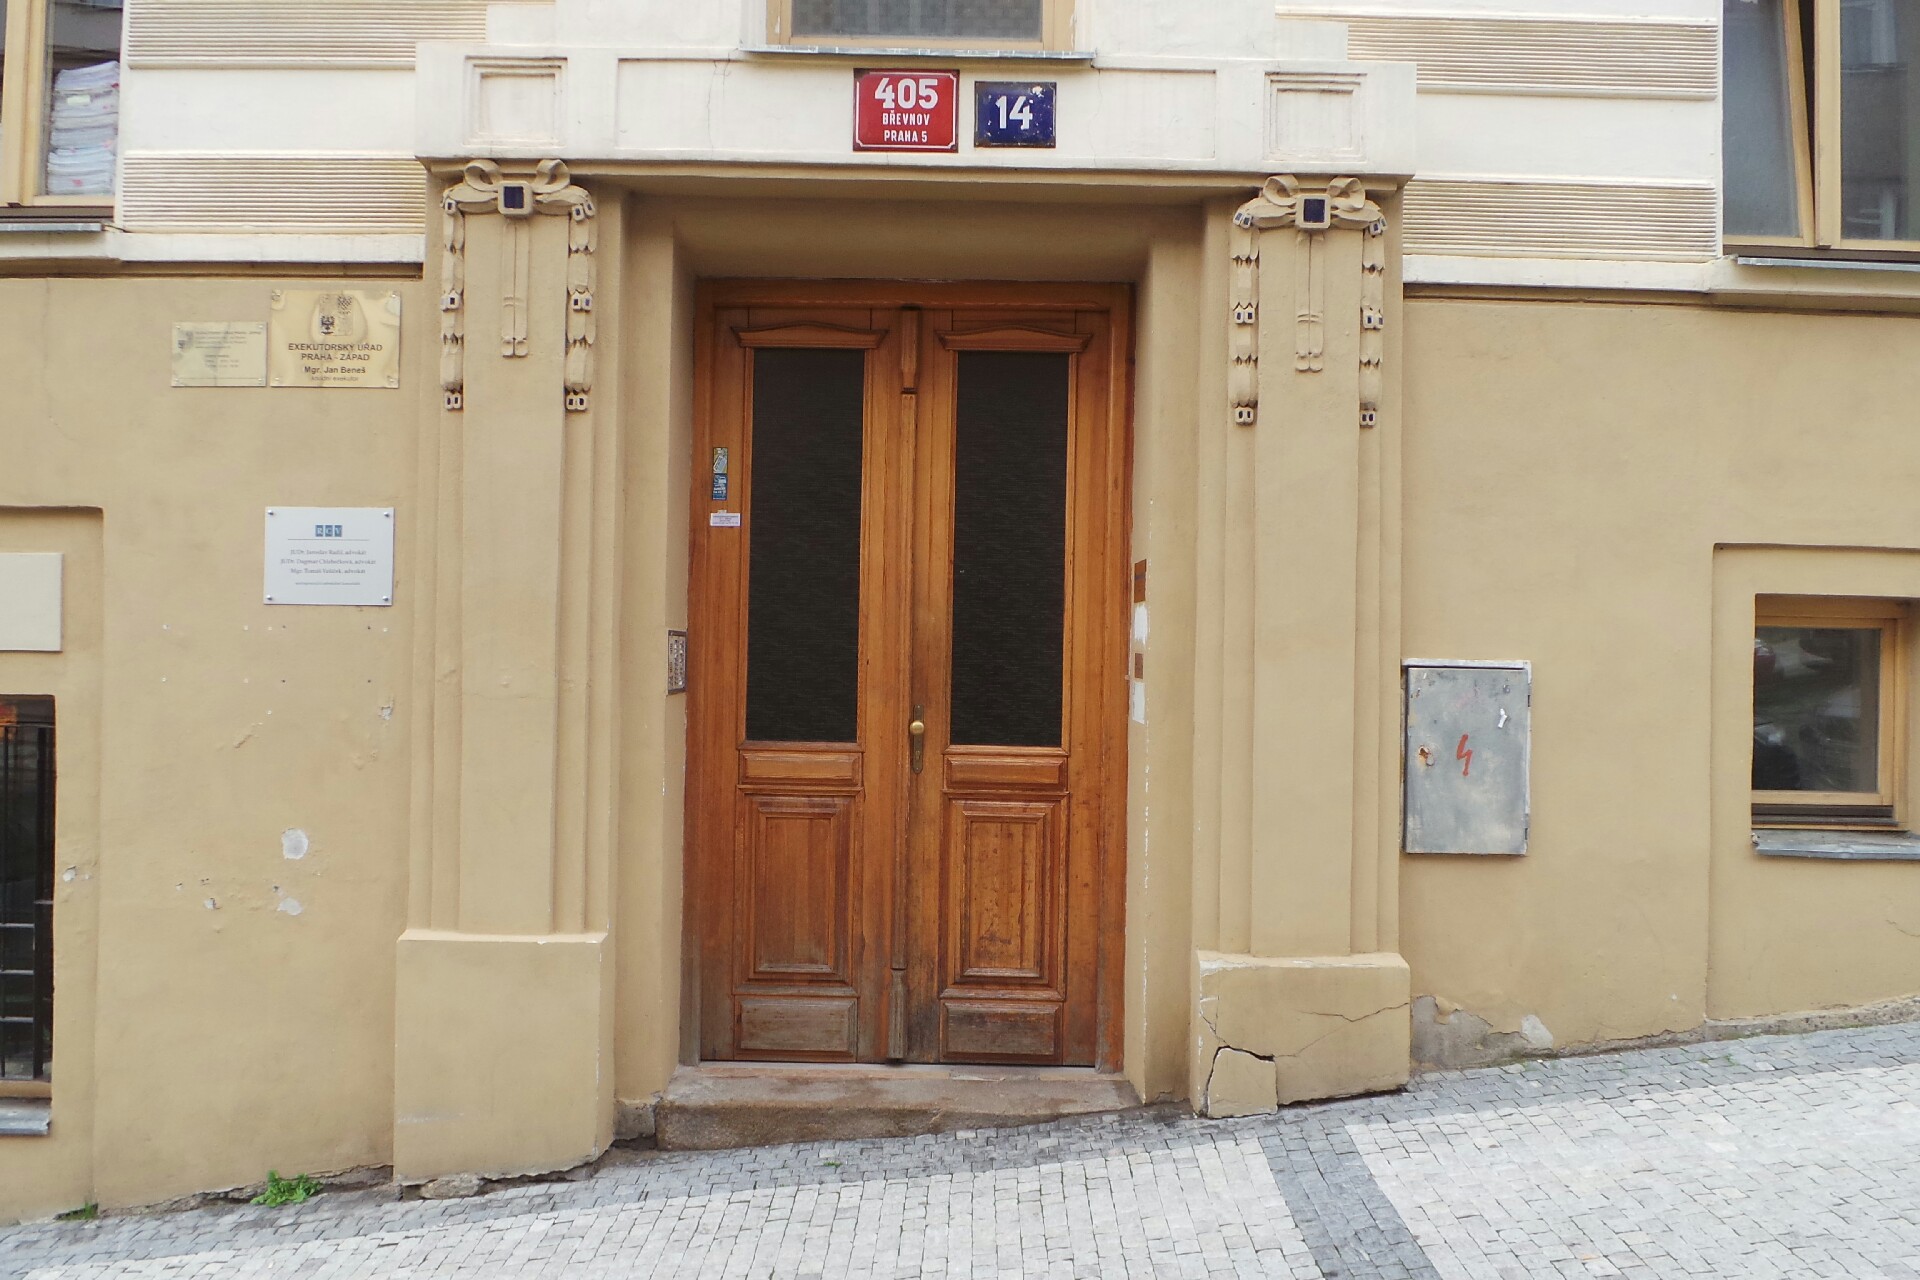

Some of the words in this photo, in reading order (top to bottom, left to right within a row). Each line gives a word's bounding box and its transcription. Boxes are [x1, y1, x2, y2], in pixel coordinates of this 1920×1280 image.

[874, 77, 938, 109] 405
[882, 110, 930, 125] BŘEVNOV
[995, 95, 1033, 130] 14
[884, 130, 918, 142] PRAHA
[921, 130, 928, 143] 5
[304, 366, 321, 374] Mgr.
